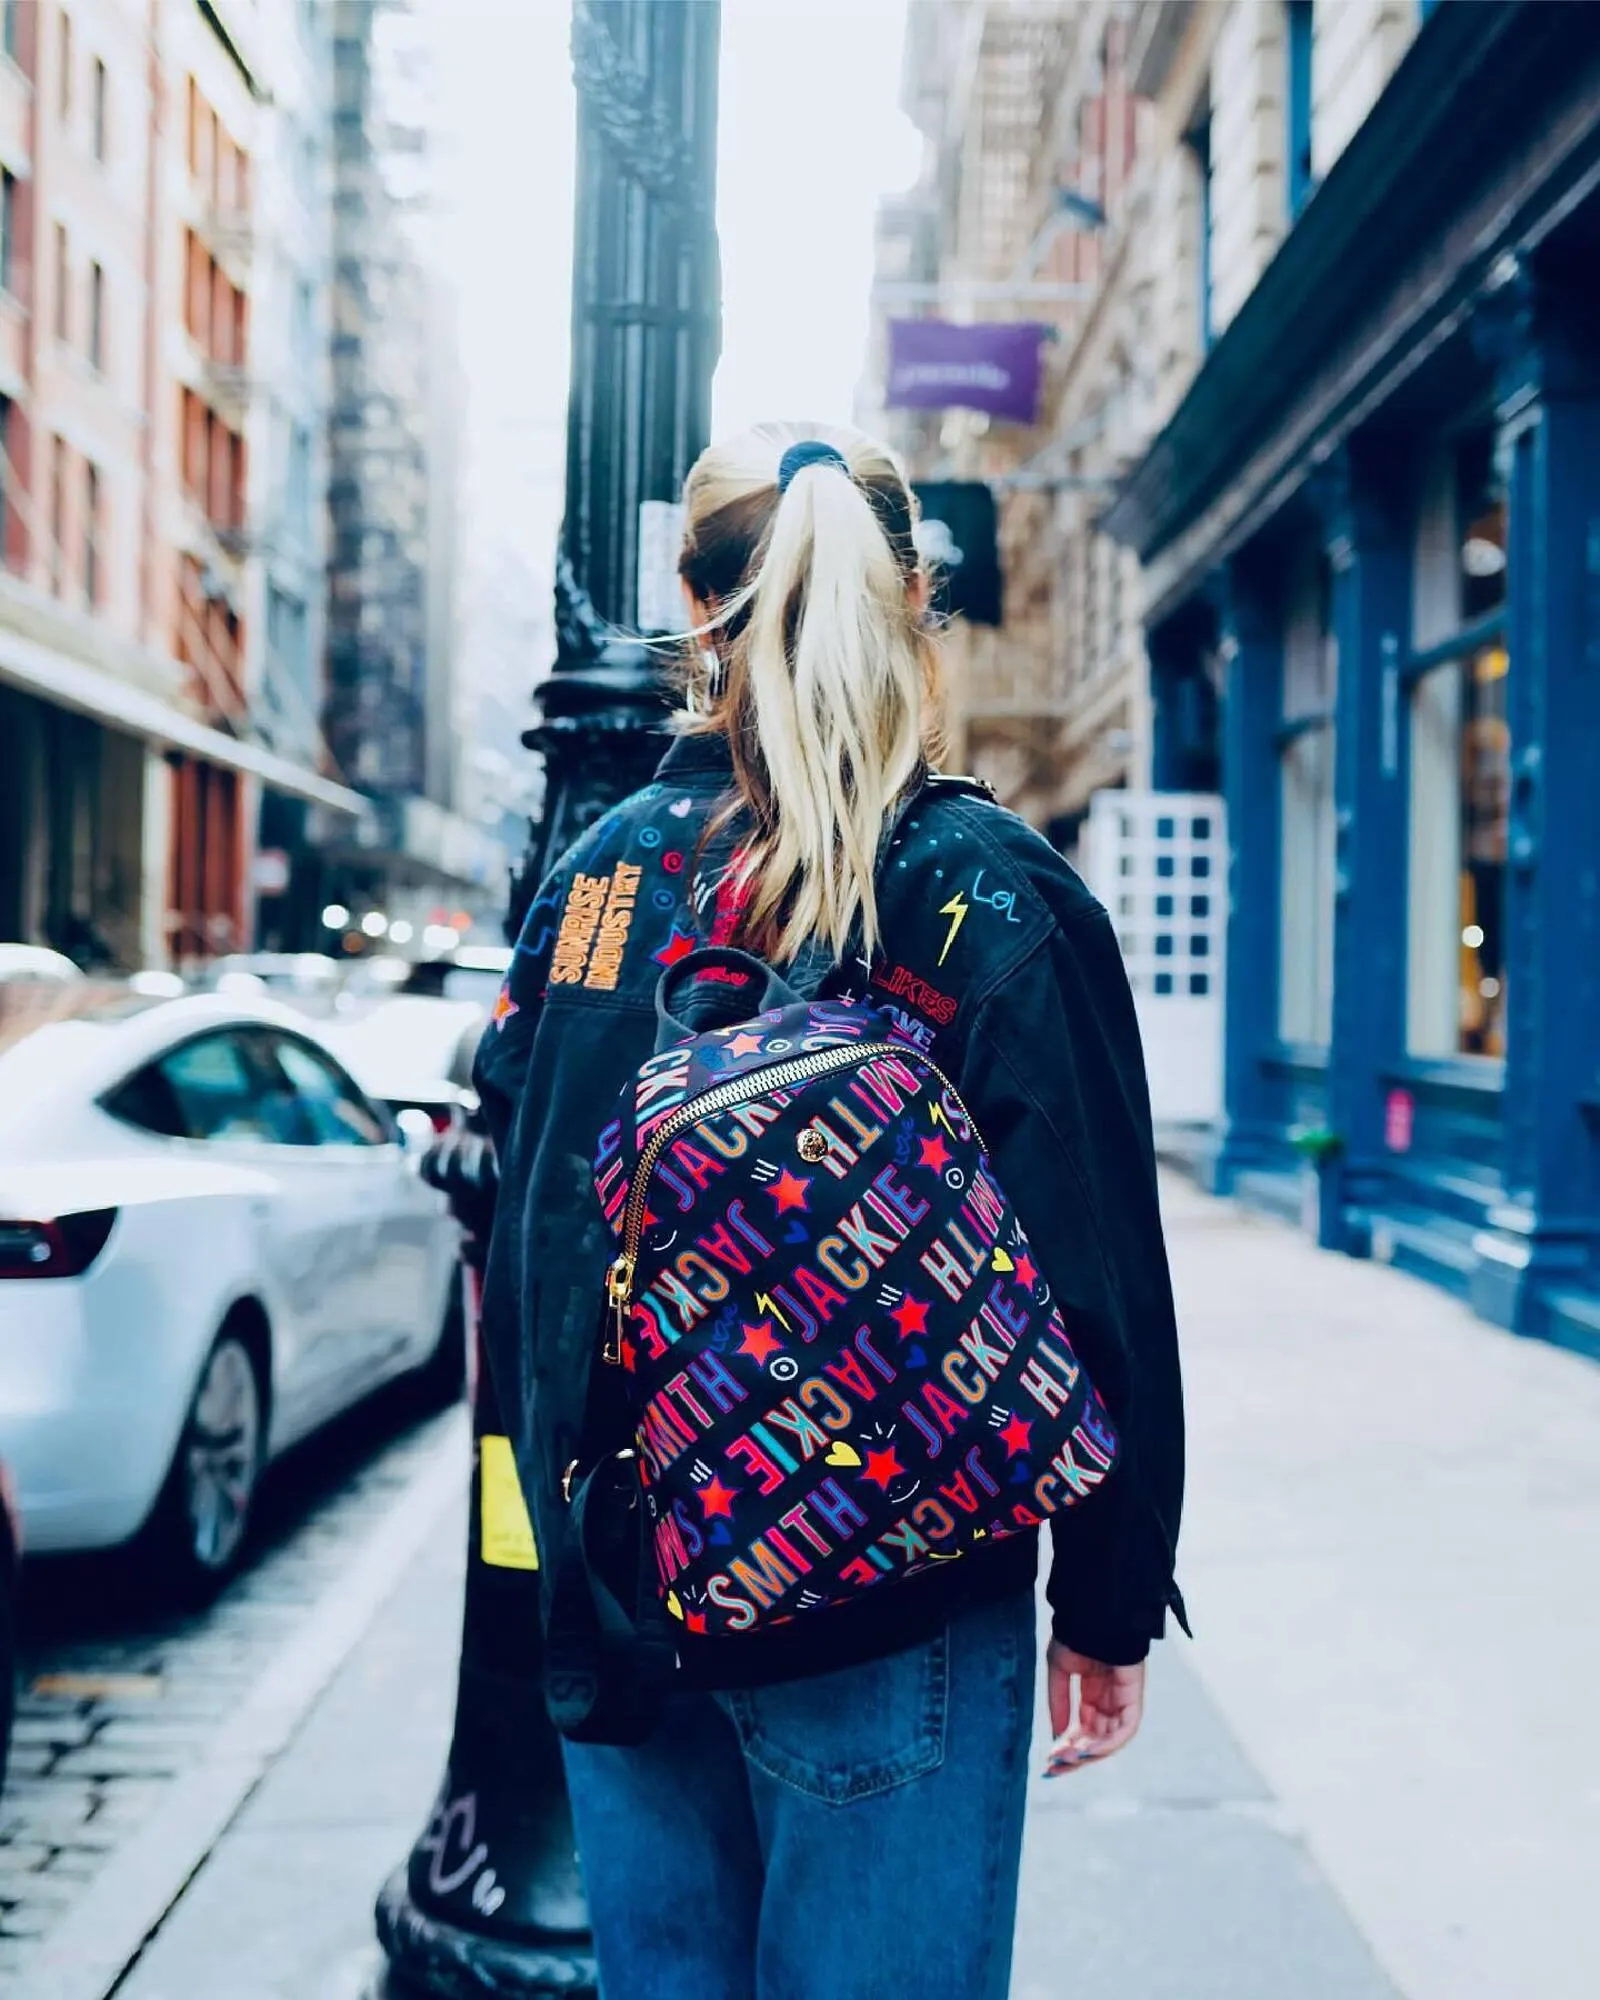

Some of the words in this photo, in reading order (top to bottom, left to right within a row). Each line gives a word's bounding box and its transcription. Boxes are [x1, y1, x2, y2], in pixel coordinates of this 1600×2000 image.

[582, 860, 644, 992] INDUSTRY
[972, 868, 1022, 924] LOL
[871, 957, 958, 1026] LIKES
[654, 1078, 817, 1213] JACK
[809, 1053, 929, 1180] MITH
[630, 1199, 776, 1361] JACKIE
[771, 1163, 931, 1344] JACKIE
[724, 1324, 898, 1497] JACKIE
[902, 1279, 1030, 1459] JACKIE
[707, 1476, 870, 1630] SMITH
